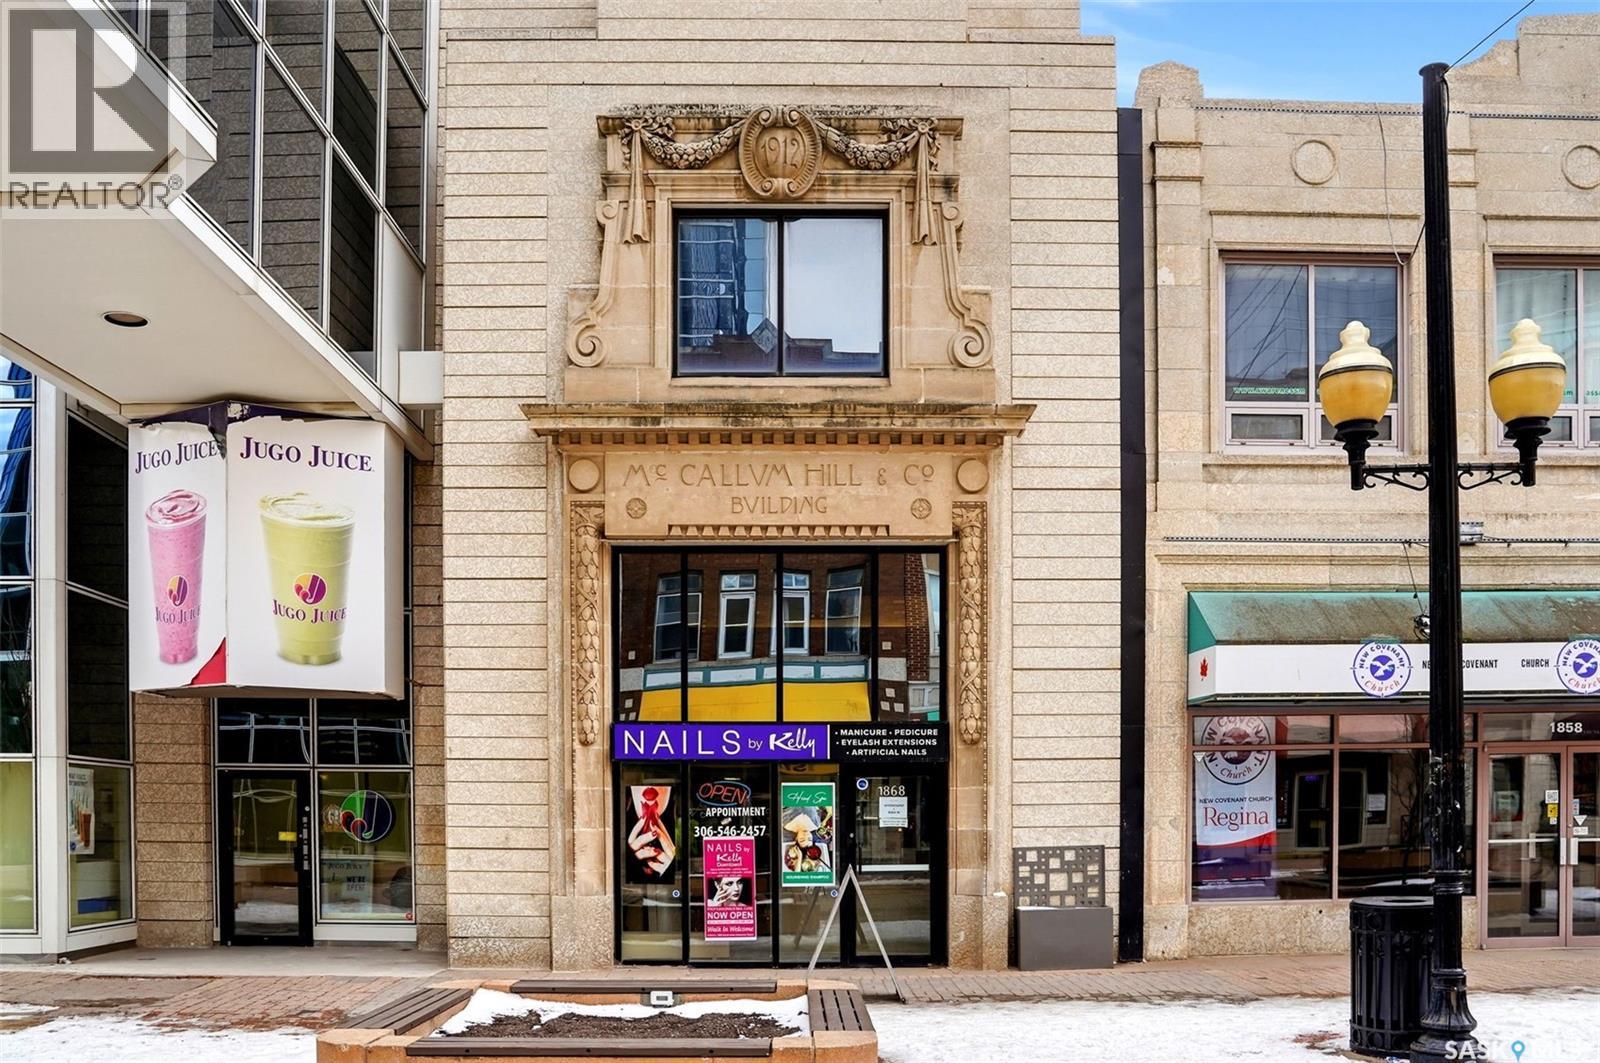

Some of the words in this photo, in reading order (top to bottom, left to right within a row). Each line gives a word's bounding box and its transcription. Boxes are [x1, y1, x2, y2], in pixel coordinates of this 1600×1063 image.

[760, 135, 799, 169] 1912
[240, 436, 301, 463] JUGO
[804, 463, 863, 487] HILL
[1359, 651, 1370, 669] NEW
[1370, 644, 1405, 668] COVENANT
[1521, 658, 1550, 668] CHURCH
[1562, 649, 1573, 667] NEW
[1364, 679, 1400, 692] Church
[840, 728, 887, 736] MANICURE
[894, 728, 939, 736] PEDICURE
[1549, 721, 1583, 734] 1858
[623, 729, 742, 756] NAILS
[748, 737, 764, 751] by
[769, 727, 817, 759] Kelly
[841, 738, 881, 747] EYELASH
[882, 738, 938, 747] EXTENSIONS
[851, 748, 899, 757] ARTIFICIAL
[901, 748, 928, 757] NAILS
[1220, 766, 1253, 779] Church
[699, 782, 748, 805] OPEN
[877, 784, 906, 797] 1868
[705, 806, 767, 817] APPOINTMENT
[1203, 806, 1269, 832] Regina
[693, 825, 767, 837] 306-546-2457
[706, 843, 742, 853] NAILS
[707, 911, 728, 920] NOW
[730, 911, 754, 920] OPEN
